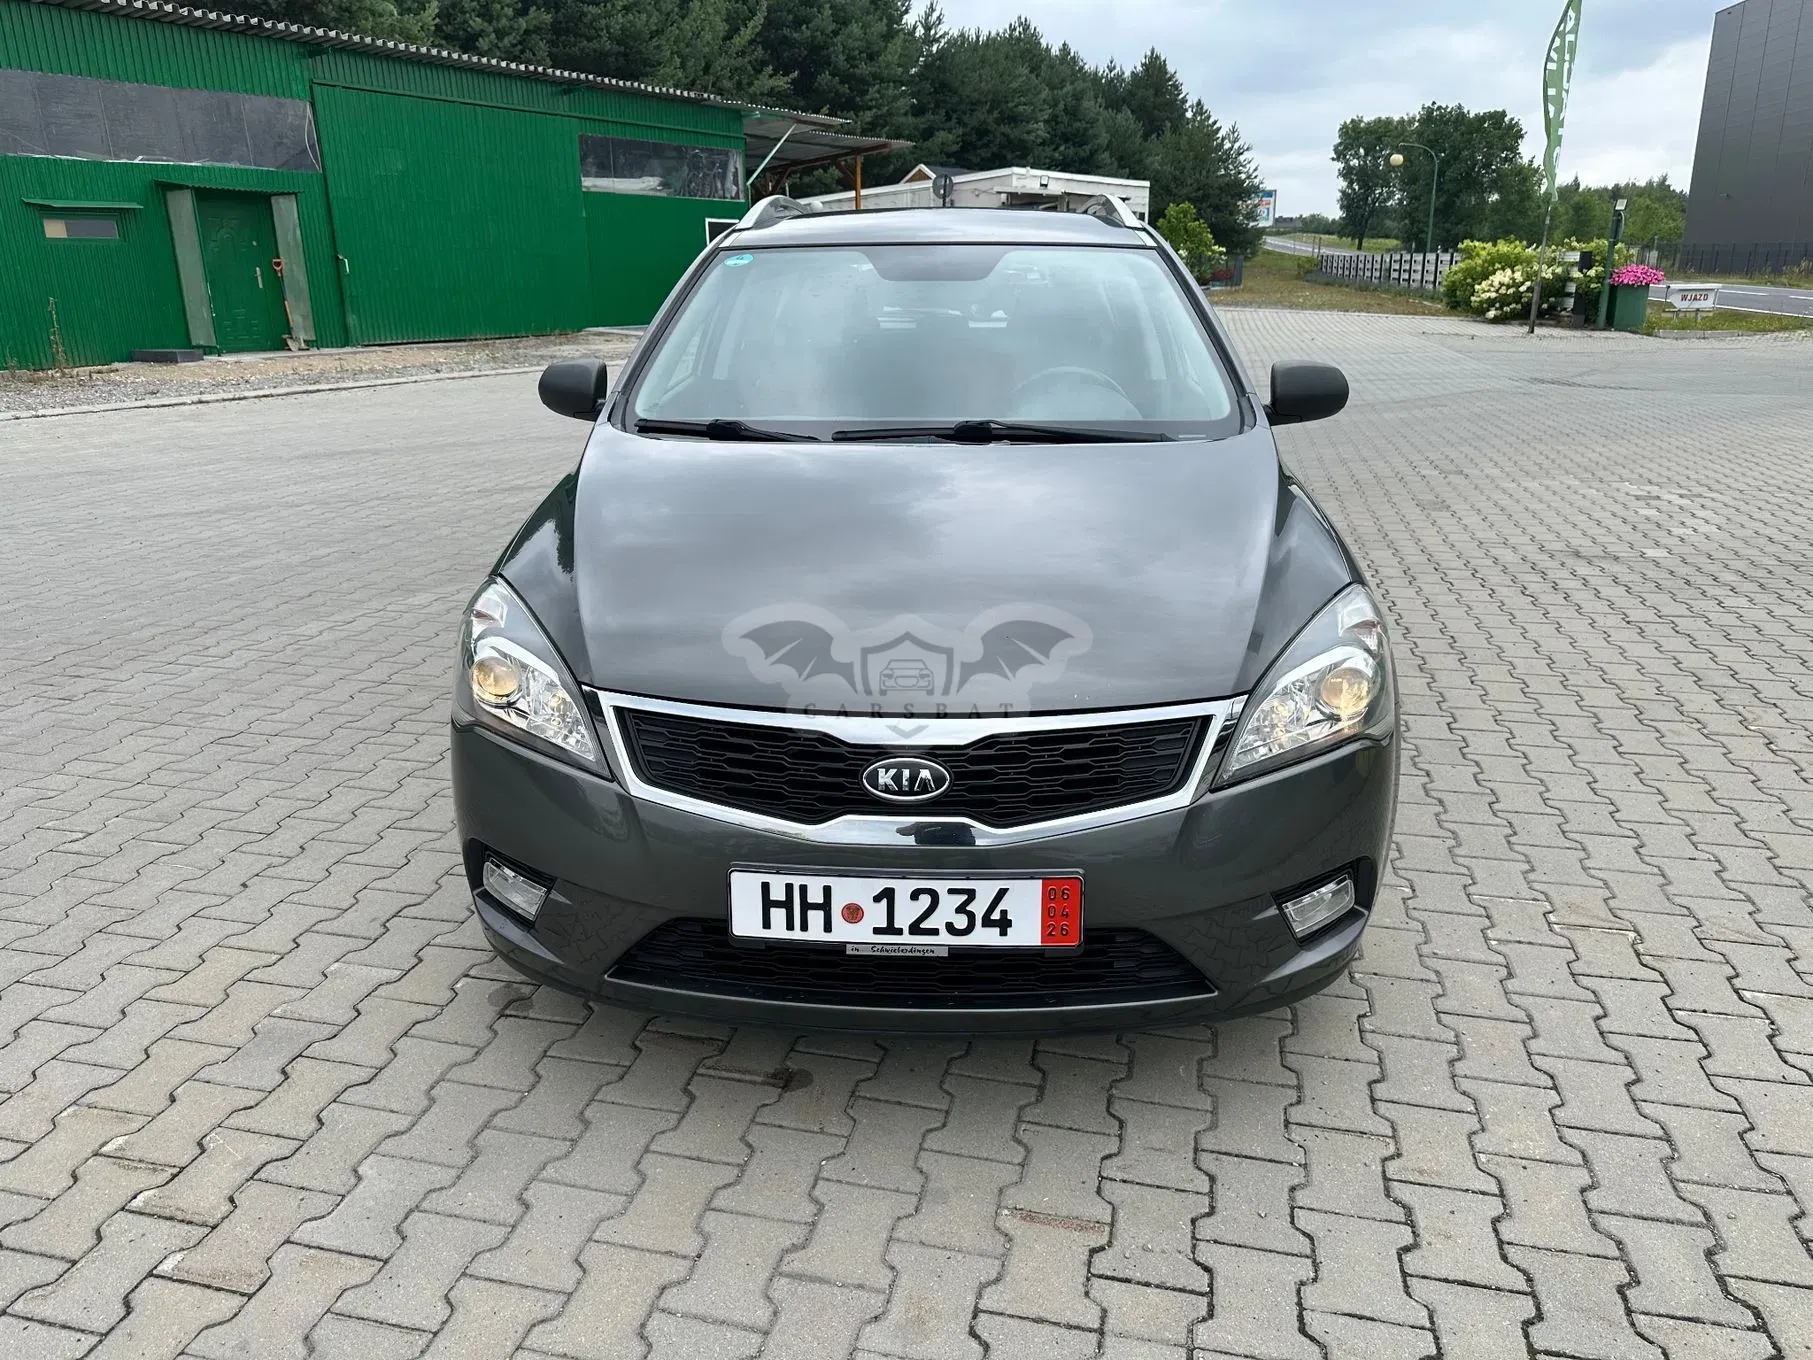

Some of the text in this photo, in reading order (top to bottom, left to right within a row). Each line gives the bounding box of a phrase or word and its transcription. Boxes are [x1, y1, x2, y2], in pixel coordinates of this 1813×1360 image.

[1680, 293, 1709, 302] WJAZD
[877, 768, 935, 791] KIA
[1047, 885, 1070, 900] 06
[761, 881, 1012, 937] HH 1234
[1047, 903, 1070, 919] 04
[1047, 921, 1070, 937] 26
[850, 945, 861, 953] in
